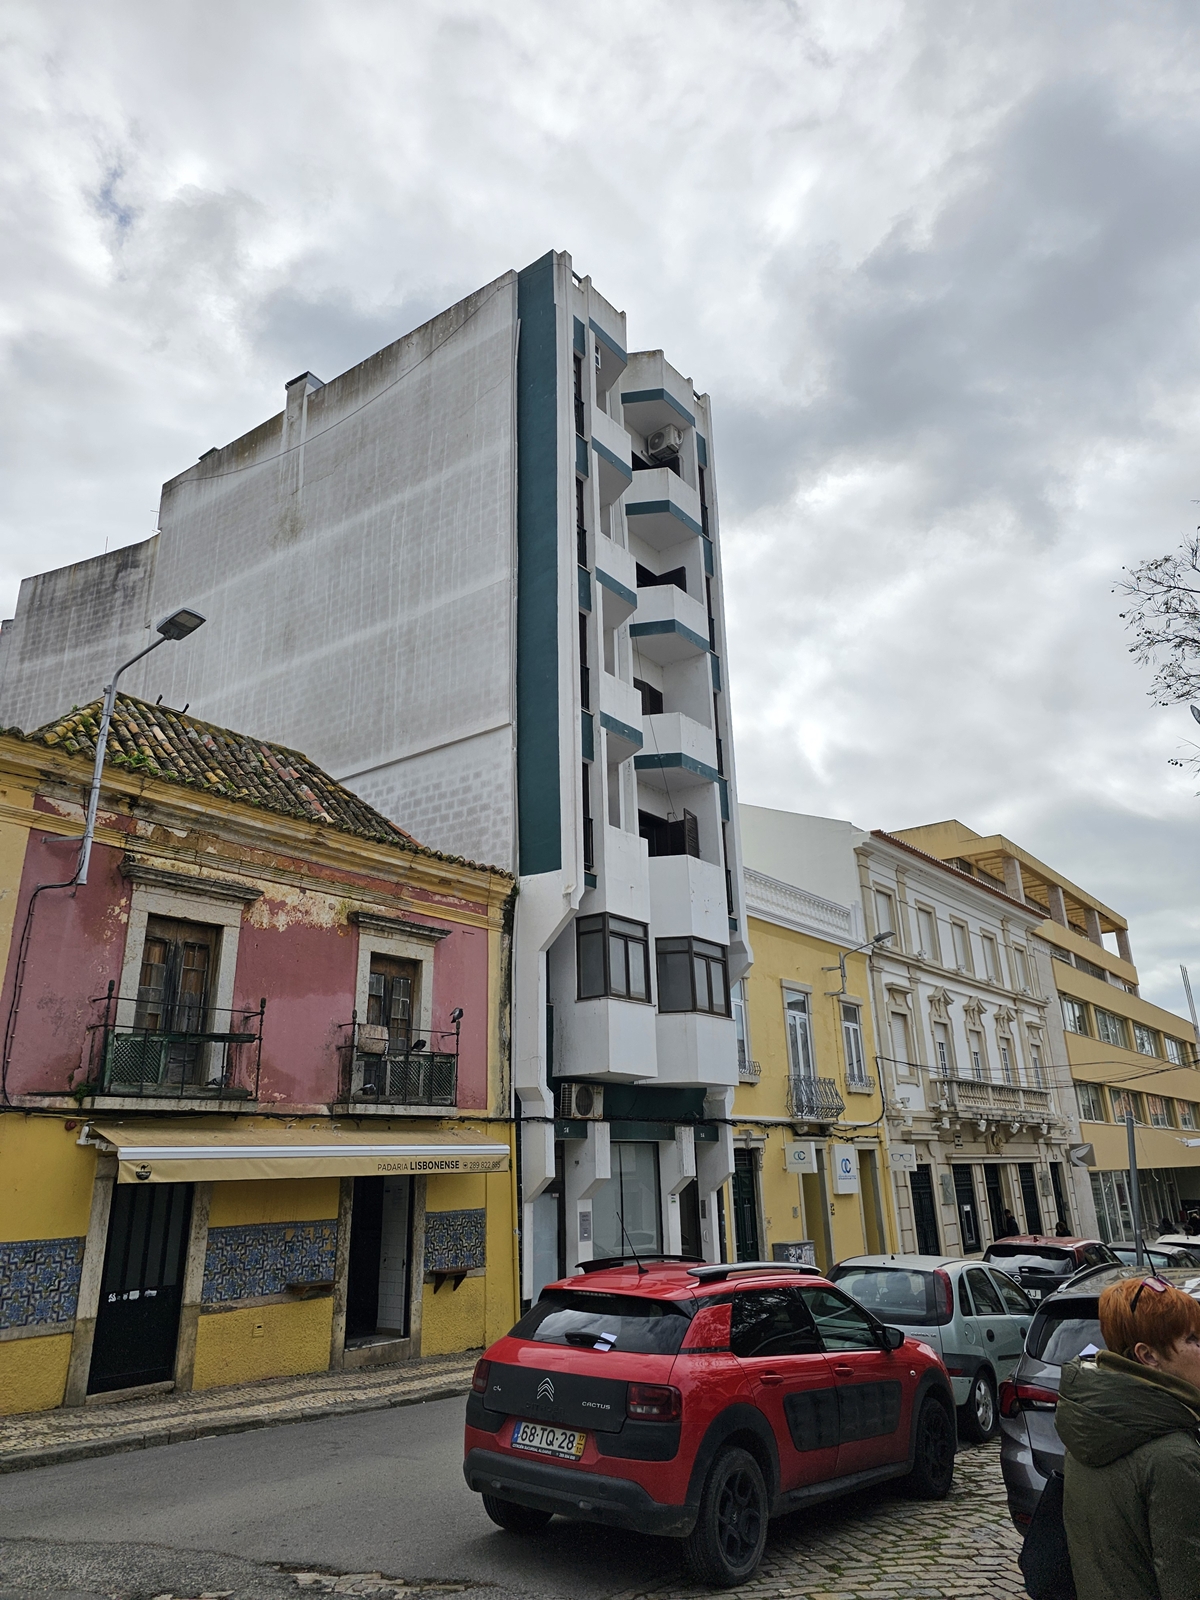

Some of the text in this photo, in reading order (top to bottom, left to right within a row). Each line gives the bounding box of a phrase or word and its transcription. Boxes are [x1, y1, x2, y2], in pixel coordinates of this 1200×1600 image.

[377, 1163, 408, 1171] PADARIA
[410, 1160, 460, 1170] LISBONENSE
[469, 1161, 480, 1169] 289
[481, 1161, 491, 1169] 822
[581, 1401, 611, 1410] CACTUS
